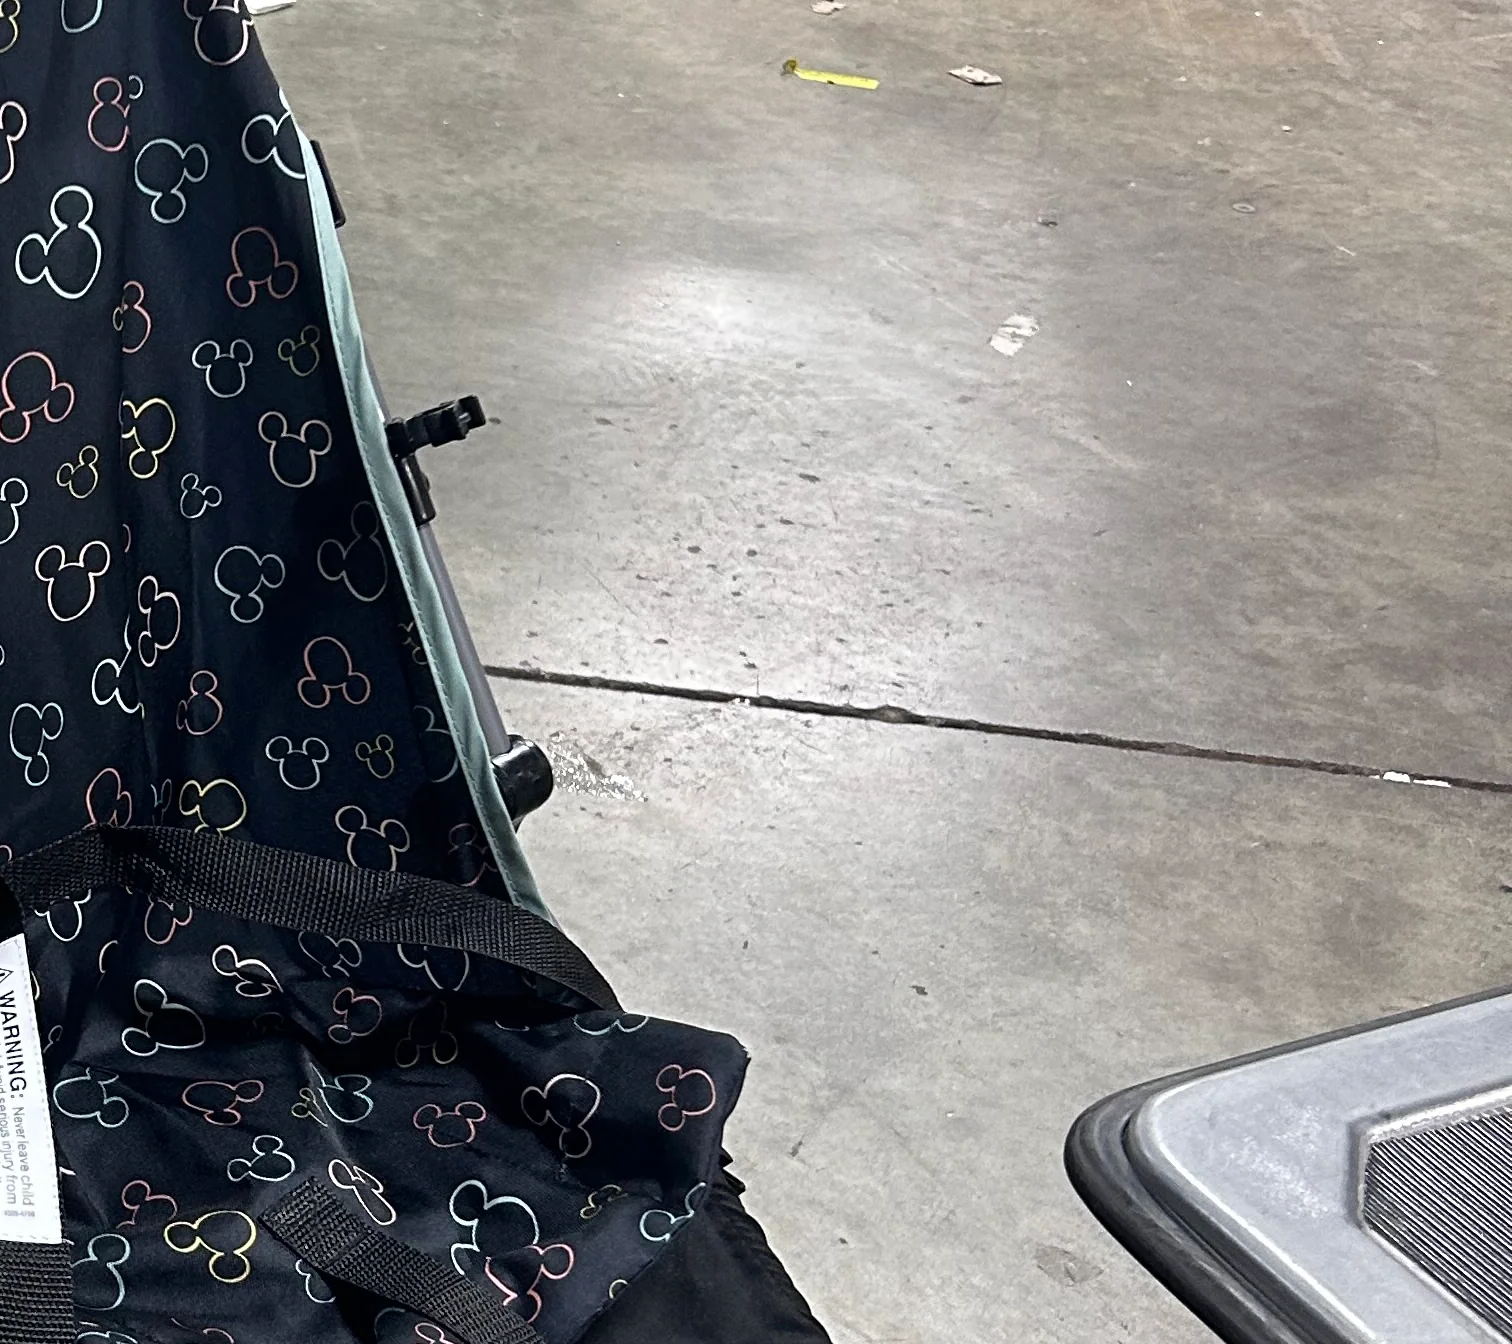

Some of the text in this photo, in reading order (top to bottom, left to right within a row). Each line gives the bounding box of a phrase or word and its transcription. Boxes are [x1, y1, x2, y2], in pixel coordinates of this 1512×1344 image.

[12, 1106, 26, 1139] Never
[0, 1141, 14, 1172] injury
[17, 1140, 30, 1172] leave
[5, 1175, 18, 1205] from
[20, 1175, 35, 1206] child
